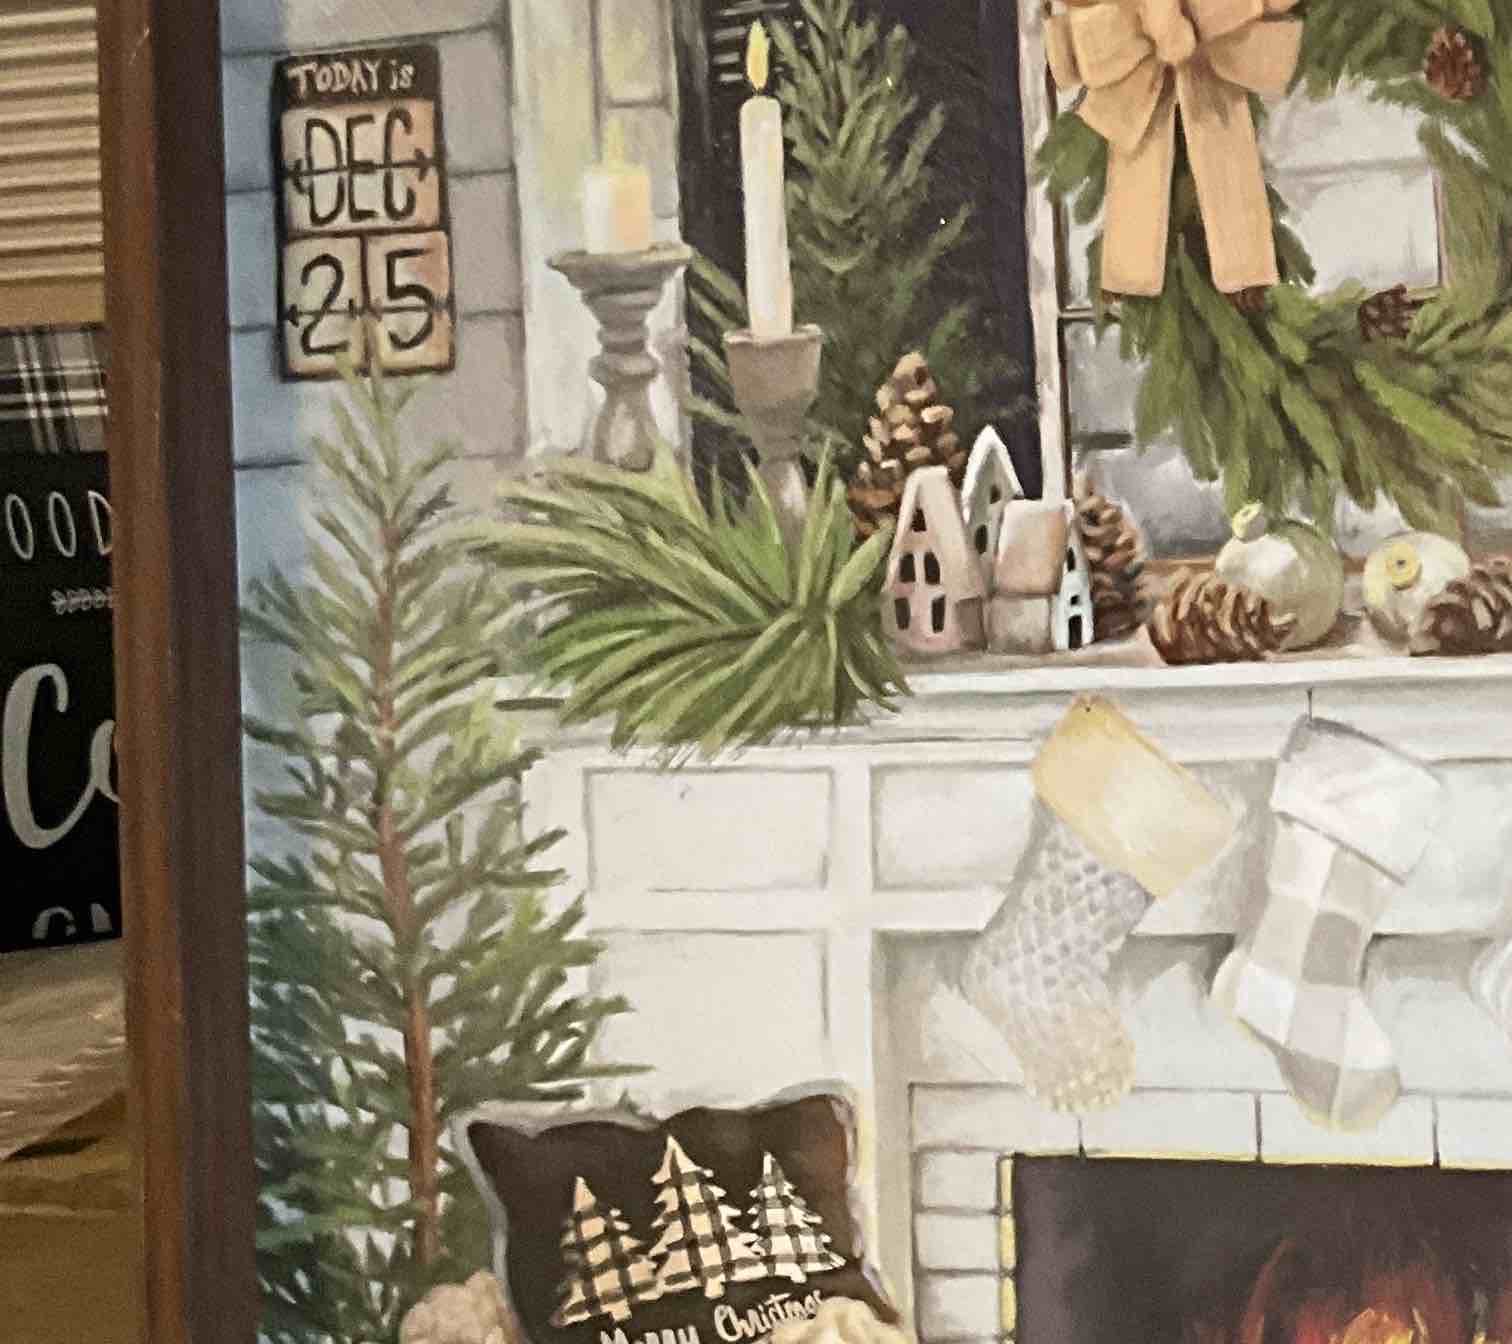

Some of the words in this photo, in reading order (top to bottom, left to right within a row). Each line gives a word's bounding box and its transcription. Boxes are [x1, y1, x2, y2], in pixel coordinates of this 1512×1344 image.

[287, 58, 380, 97] TODAY
[304, 106, 417, 226] DEC
[302, 248, 435, 355] 25
